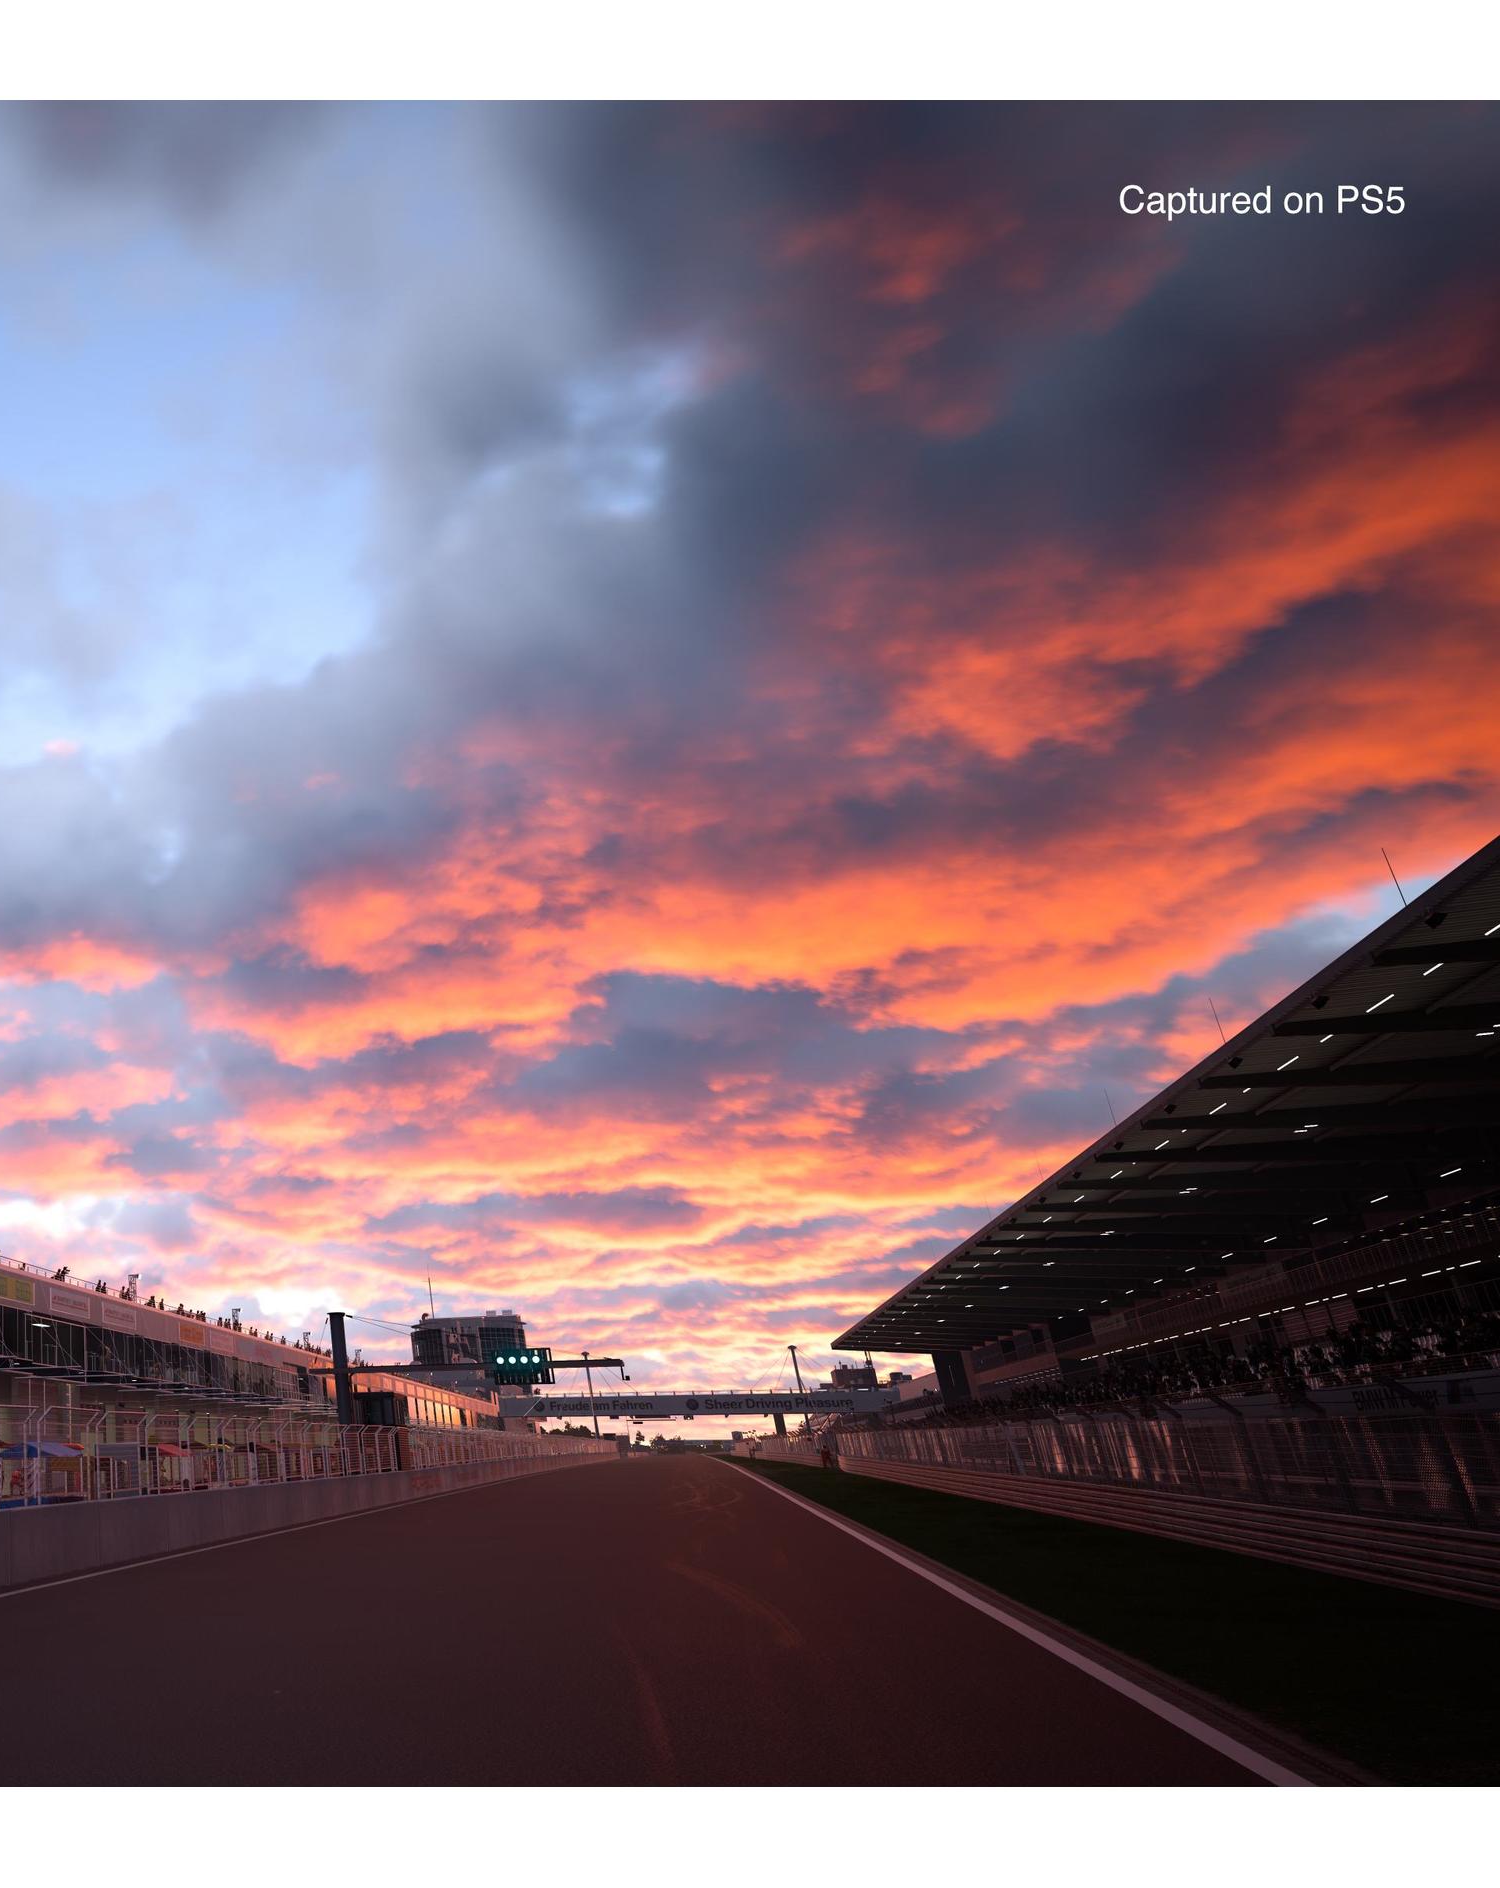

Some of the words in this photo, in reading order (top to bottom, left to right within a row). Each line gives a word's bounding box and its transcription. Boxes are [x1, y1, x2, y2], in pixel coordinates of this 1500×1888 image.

[549, 1401, 591, 1412] Freude
[592, 1402, 611, 1411] am
[612, 1399, 654, 1411] Fahren
[704, 1399, 744, 1410] Sheer
[746, 1398, 793, 1412] Driving
[794, 1397, 854, 1410] Pleasure
